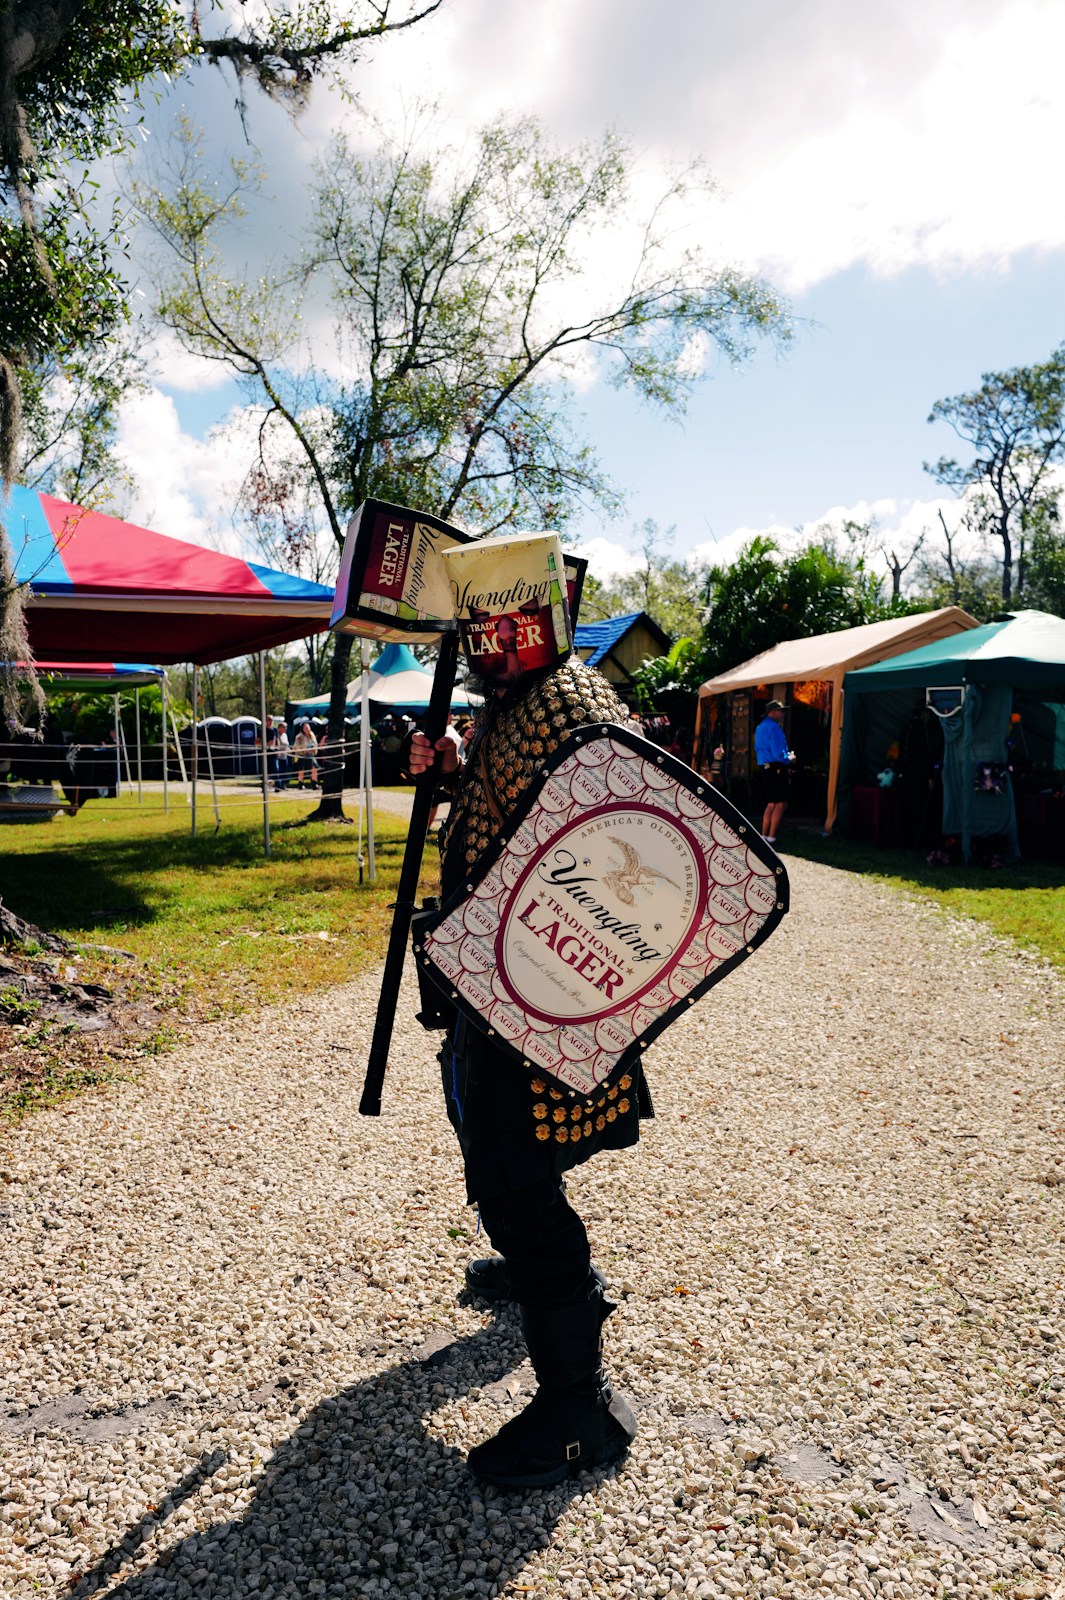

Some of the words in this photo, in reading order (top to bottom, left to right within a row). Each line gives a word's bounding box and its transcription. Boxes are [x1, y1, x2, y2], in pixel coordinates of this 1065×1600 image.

[378, 522, 404, 586] LAGER
[396, 533, 410, 582] TRADITIONAL
[404, 522, 442, 606] Yuengling
[450, 577, 549, 616] Yuengling
[470, 616, 533, 632] TRADINAL
[584, 743, 605, 761] AGER
[575, 774, 600, 800] LAGER
[611, 766, 638, 792] LAGER
[544, 786, 566, 808] AGER
[680, 788, 710, 812] LAGER
[538, 820, 554, 836] LAG
[514, 831, 530, 851] AGER
[505, 862, 520, 878] LAG
[581, 818, 644, 838] AMERICA'S
[650, 822, 688, 858] OLDEST
[680, 865, 694, 920] BREWERY
[713, 856, 742, 880] LAGER
[482, 878, 496, 894] GER
[537, 850, 673, 962] Yuengling
[712, 894, 740, 918] LAGER
[440, 922, 458, 938] GER
[468, 906, 493, 931] LAGER
[546, 896, 626, 970] TRADITIONAL
[464, 944, 489, 968] LAGER
[518, 898, 624, 1000] LAGER
[430, 950, 454, 976] LAGER
[513, 940, 546, 968] Original
[541, 970, 566, 991] Amber
[567, 989, 586, 1007] Beer
[460, 980, 486, 1005] LAGER
[673, 973, 694, 990] LAGE
[493, 1010, 520, 1035] LAGER
[600, 1023, 628, 1046] LAGER
[528, 1040, 554, 1064] LAGER
[564, 1031, 590, 1056] LAGER
[562, 1068, 588, 1092] LAGER
